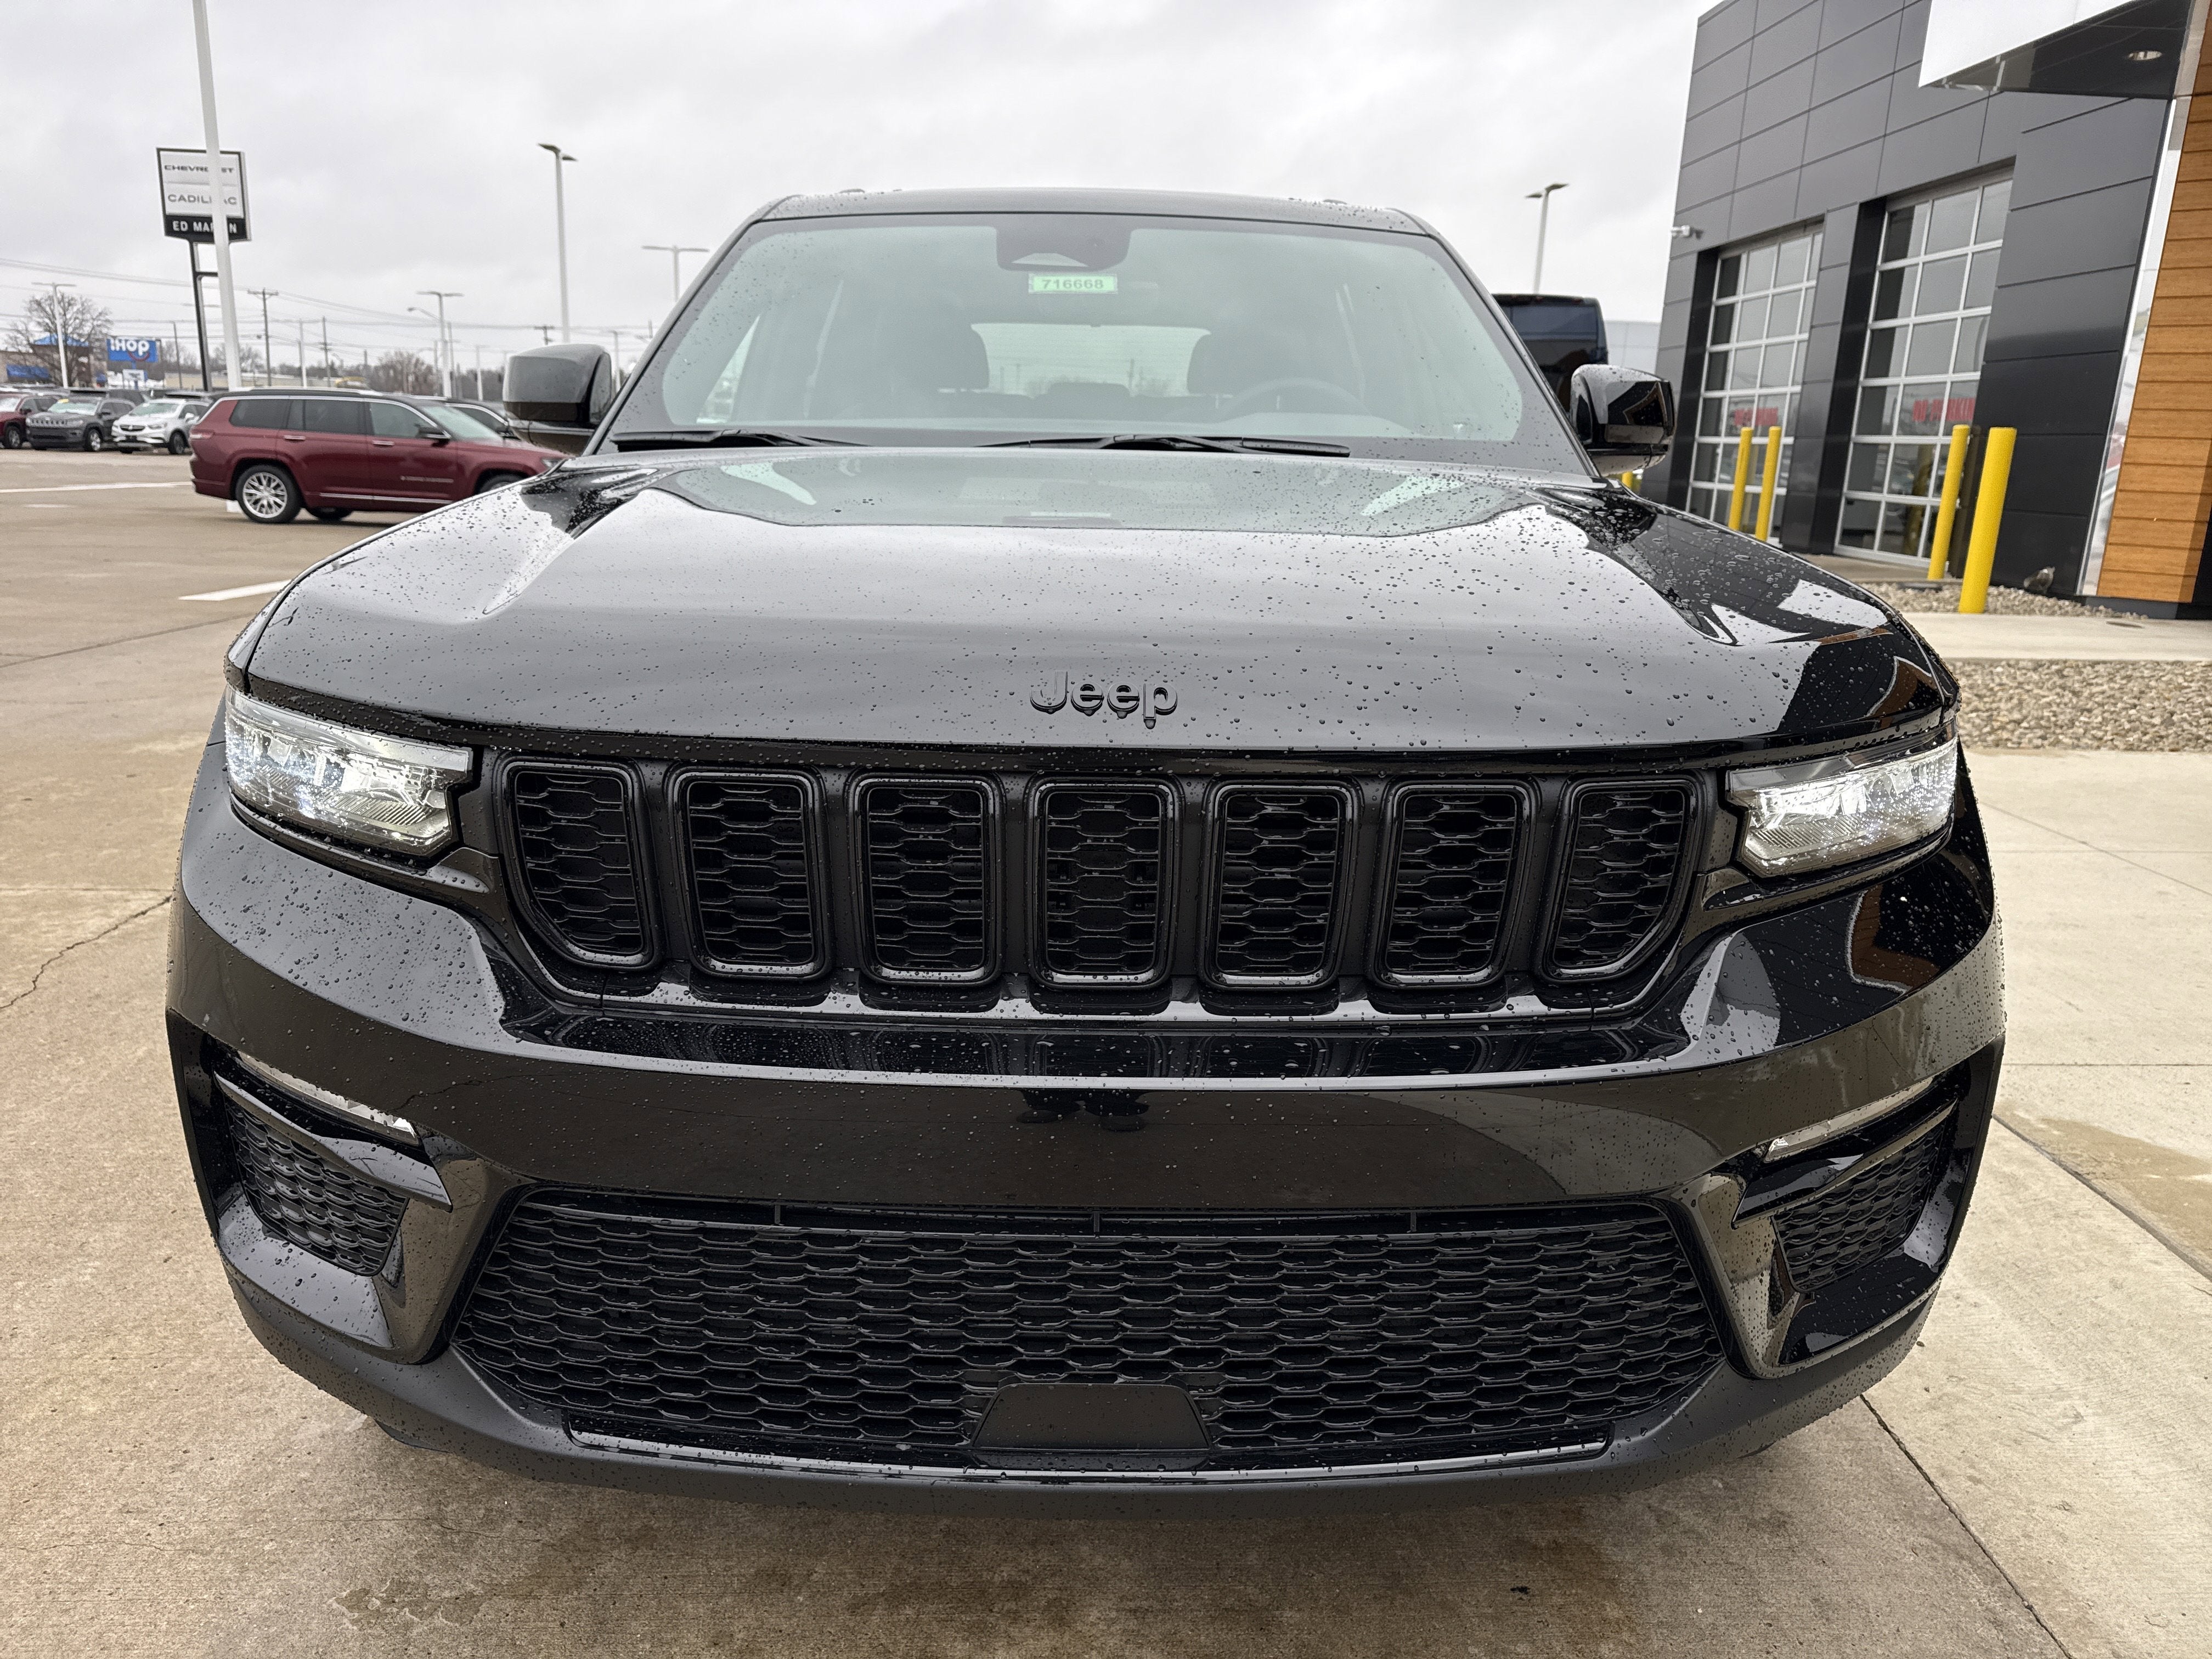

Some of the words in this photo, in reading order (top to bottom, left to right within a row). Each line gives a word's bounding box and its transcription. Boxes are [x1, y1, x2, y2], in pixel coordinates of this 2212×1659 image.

[172, 221, 188, 232] ED
[1042, 279, 1104, 289] 716668
[1030, 670, 1178, 720] Jeep
